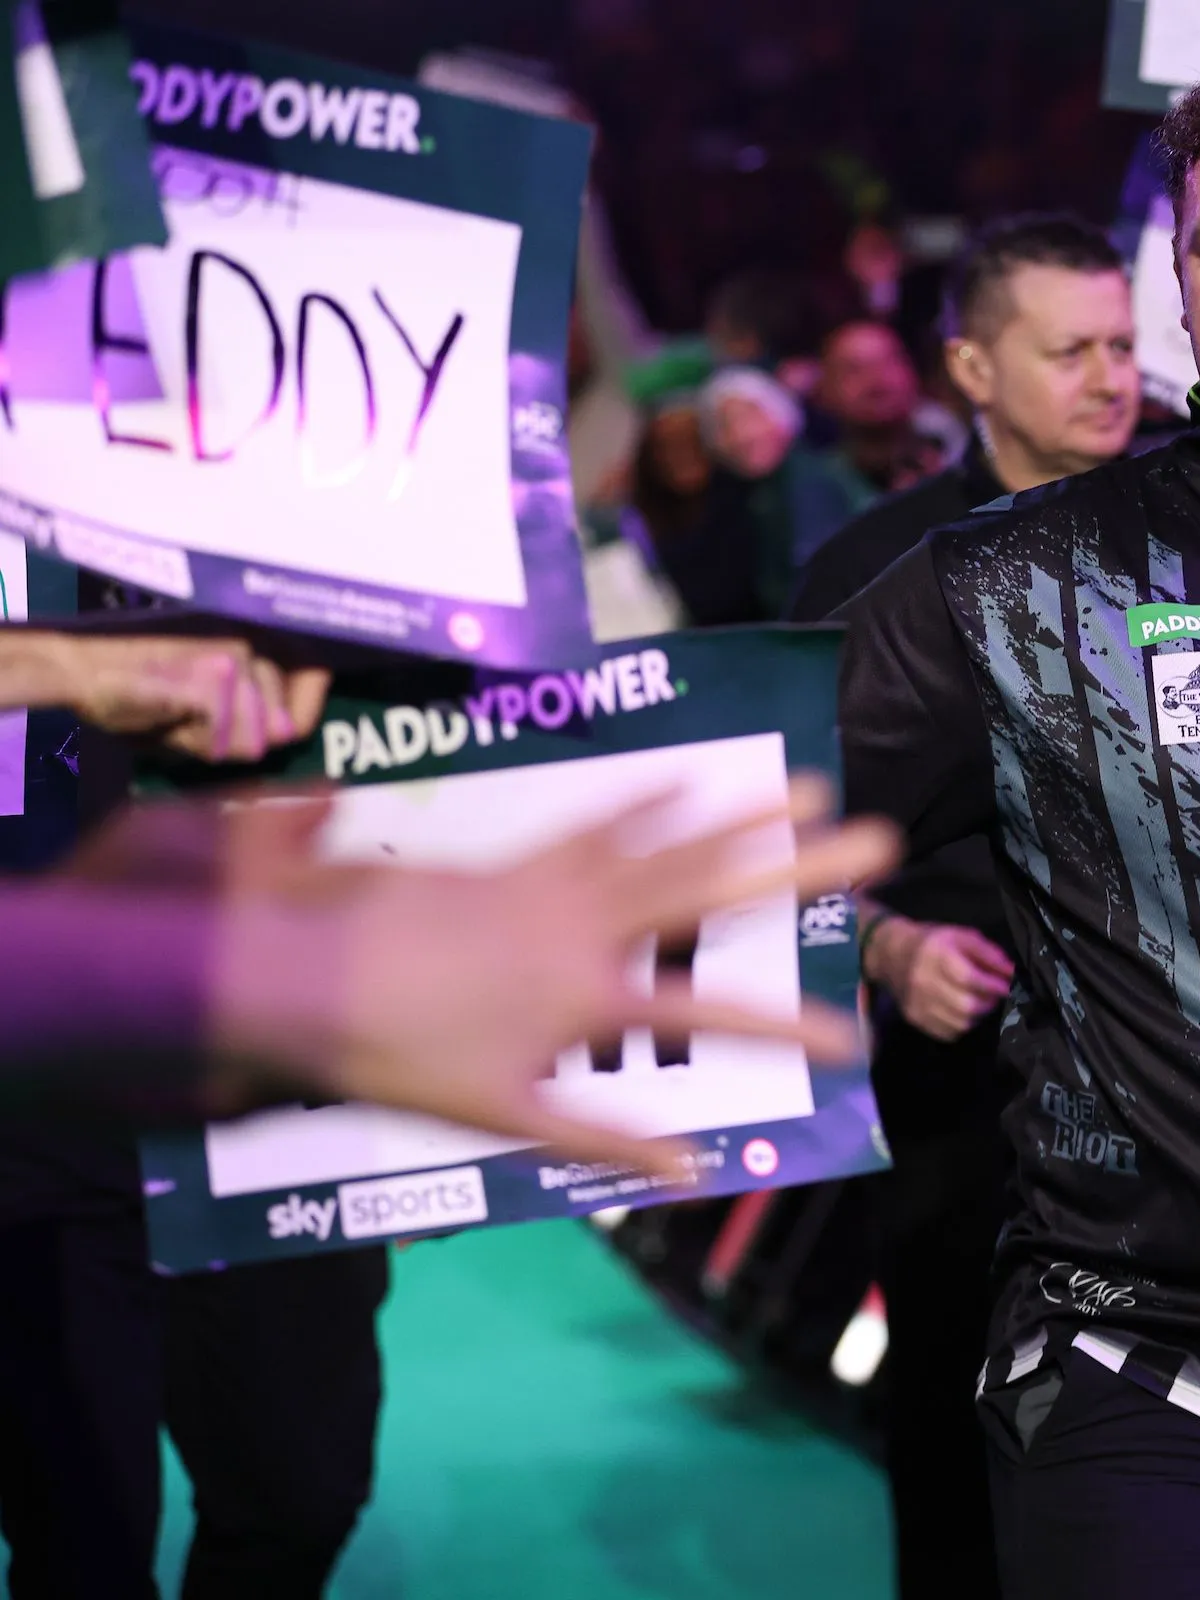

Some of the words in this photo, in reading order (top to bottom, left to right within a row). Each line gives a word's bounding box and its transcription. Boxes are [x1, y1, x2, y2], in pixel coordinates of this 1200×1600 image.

[1181, 692, 1197, 702] THE
[1046, 1085, 1094, 1121] THE
[1056, 1122, 1135, 1172] RIOT
[267, 1193, 339, 1241] sky
[350, 1181, 477, 1227] sports
